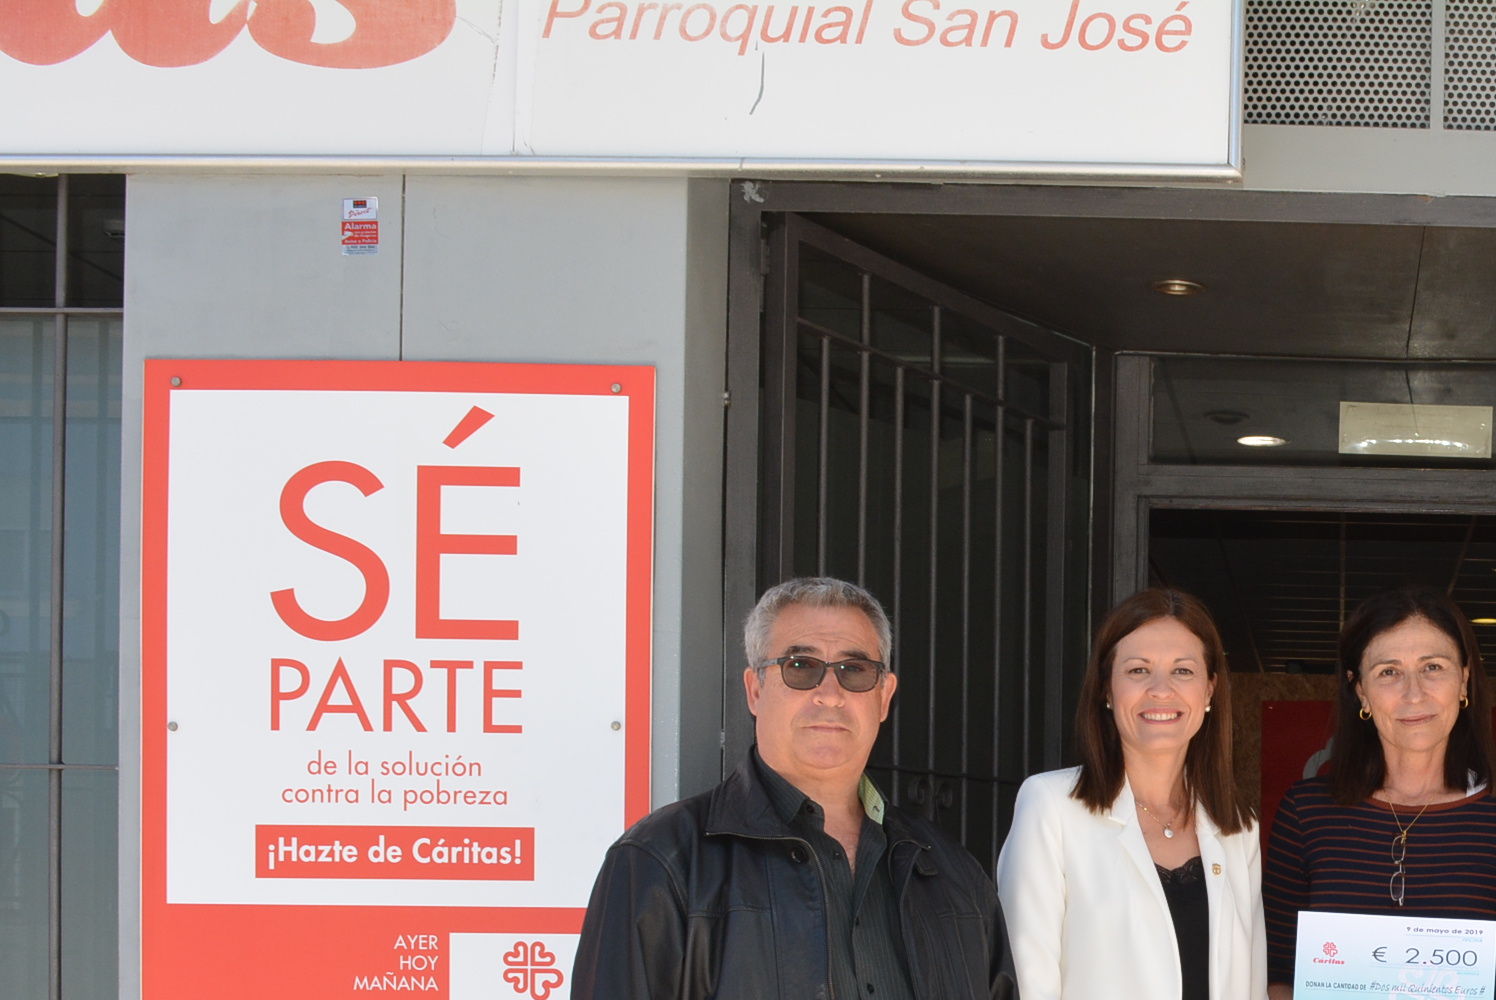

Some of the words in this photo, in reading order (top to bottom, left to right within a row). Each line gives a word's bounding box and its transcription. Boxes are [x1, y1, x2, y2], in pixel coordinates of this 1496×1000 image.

[541, 0, 871, 56] Parroquial
[893, 0, 1020, 49] San
[1039, 0, 1193, 53] José
[344, 222, 377, 230] Alarma
[270, 405, 521, 641] SÉ
[270, 656, 523, 734] PARTE
[307, 750, 338, 776] de
[348, 750, 370, 776] la
[380, 750, 483, 777] solución
[281, 781, 360, 805] contra
[371, 778, 393, 805] la
[403, 779, 508, 812] pobreza
[268, 836, 359, 870] ¡Hazte
[367, 835, 403, 864] de
[412, 837, 523, 865] Cáritas!
[393, 934, 439, 950] AYER
[399, 955, 439, 971] HOY
[1405, 947, 1478, 967] 2.500
[353, 971, 439, 991] MAÑANA
[1305, 980, 1325, 988] DONAN
[1333, 982, 1359, 990] CANTIDAD
[1391, 982, 1407, 992] mil
[1407, 982, 1453, 994] Quinientos
[1455, 985, 1478, 995] Euros
